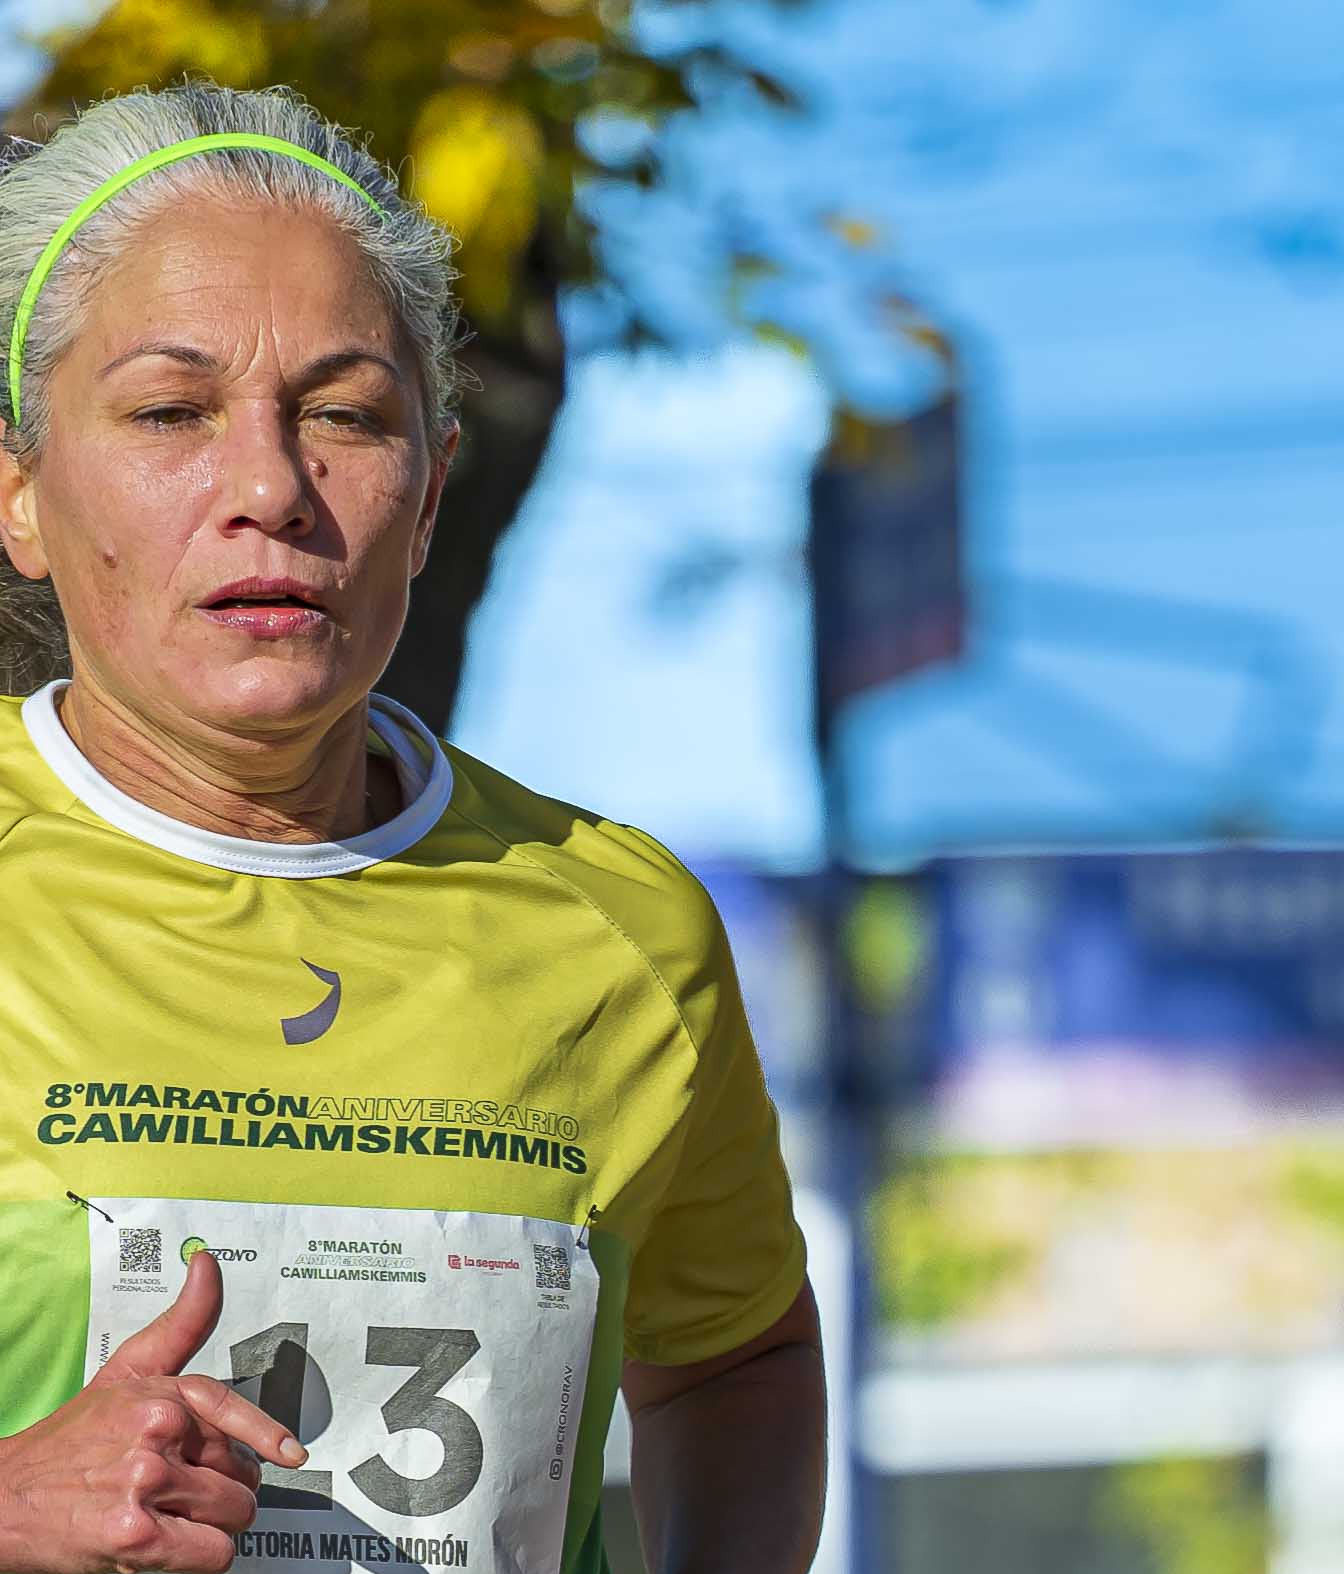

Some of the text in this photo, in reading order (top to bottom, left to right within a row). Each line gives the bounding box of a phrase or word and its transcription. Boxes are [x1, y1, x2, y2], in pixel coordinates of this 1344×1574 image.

[37, 1112, 587, 1175] CAWILLIAMSKEMMIS
[207, 1248, 258, 1262] RONO
[476, 1258, 520, 1271] segunda
[280, 1266, 427, 1283] CAWILLIAMSKEMMIS
[233, 1531, 470, 1568] ICTORIA MATES MORÓN
